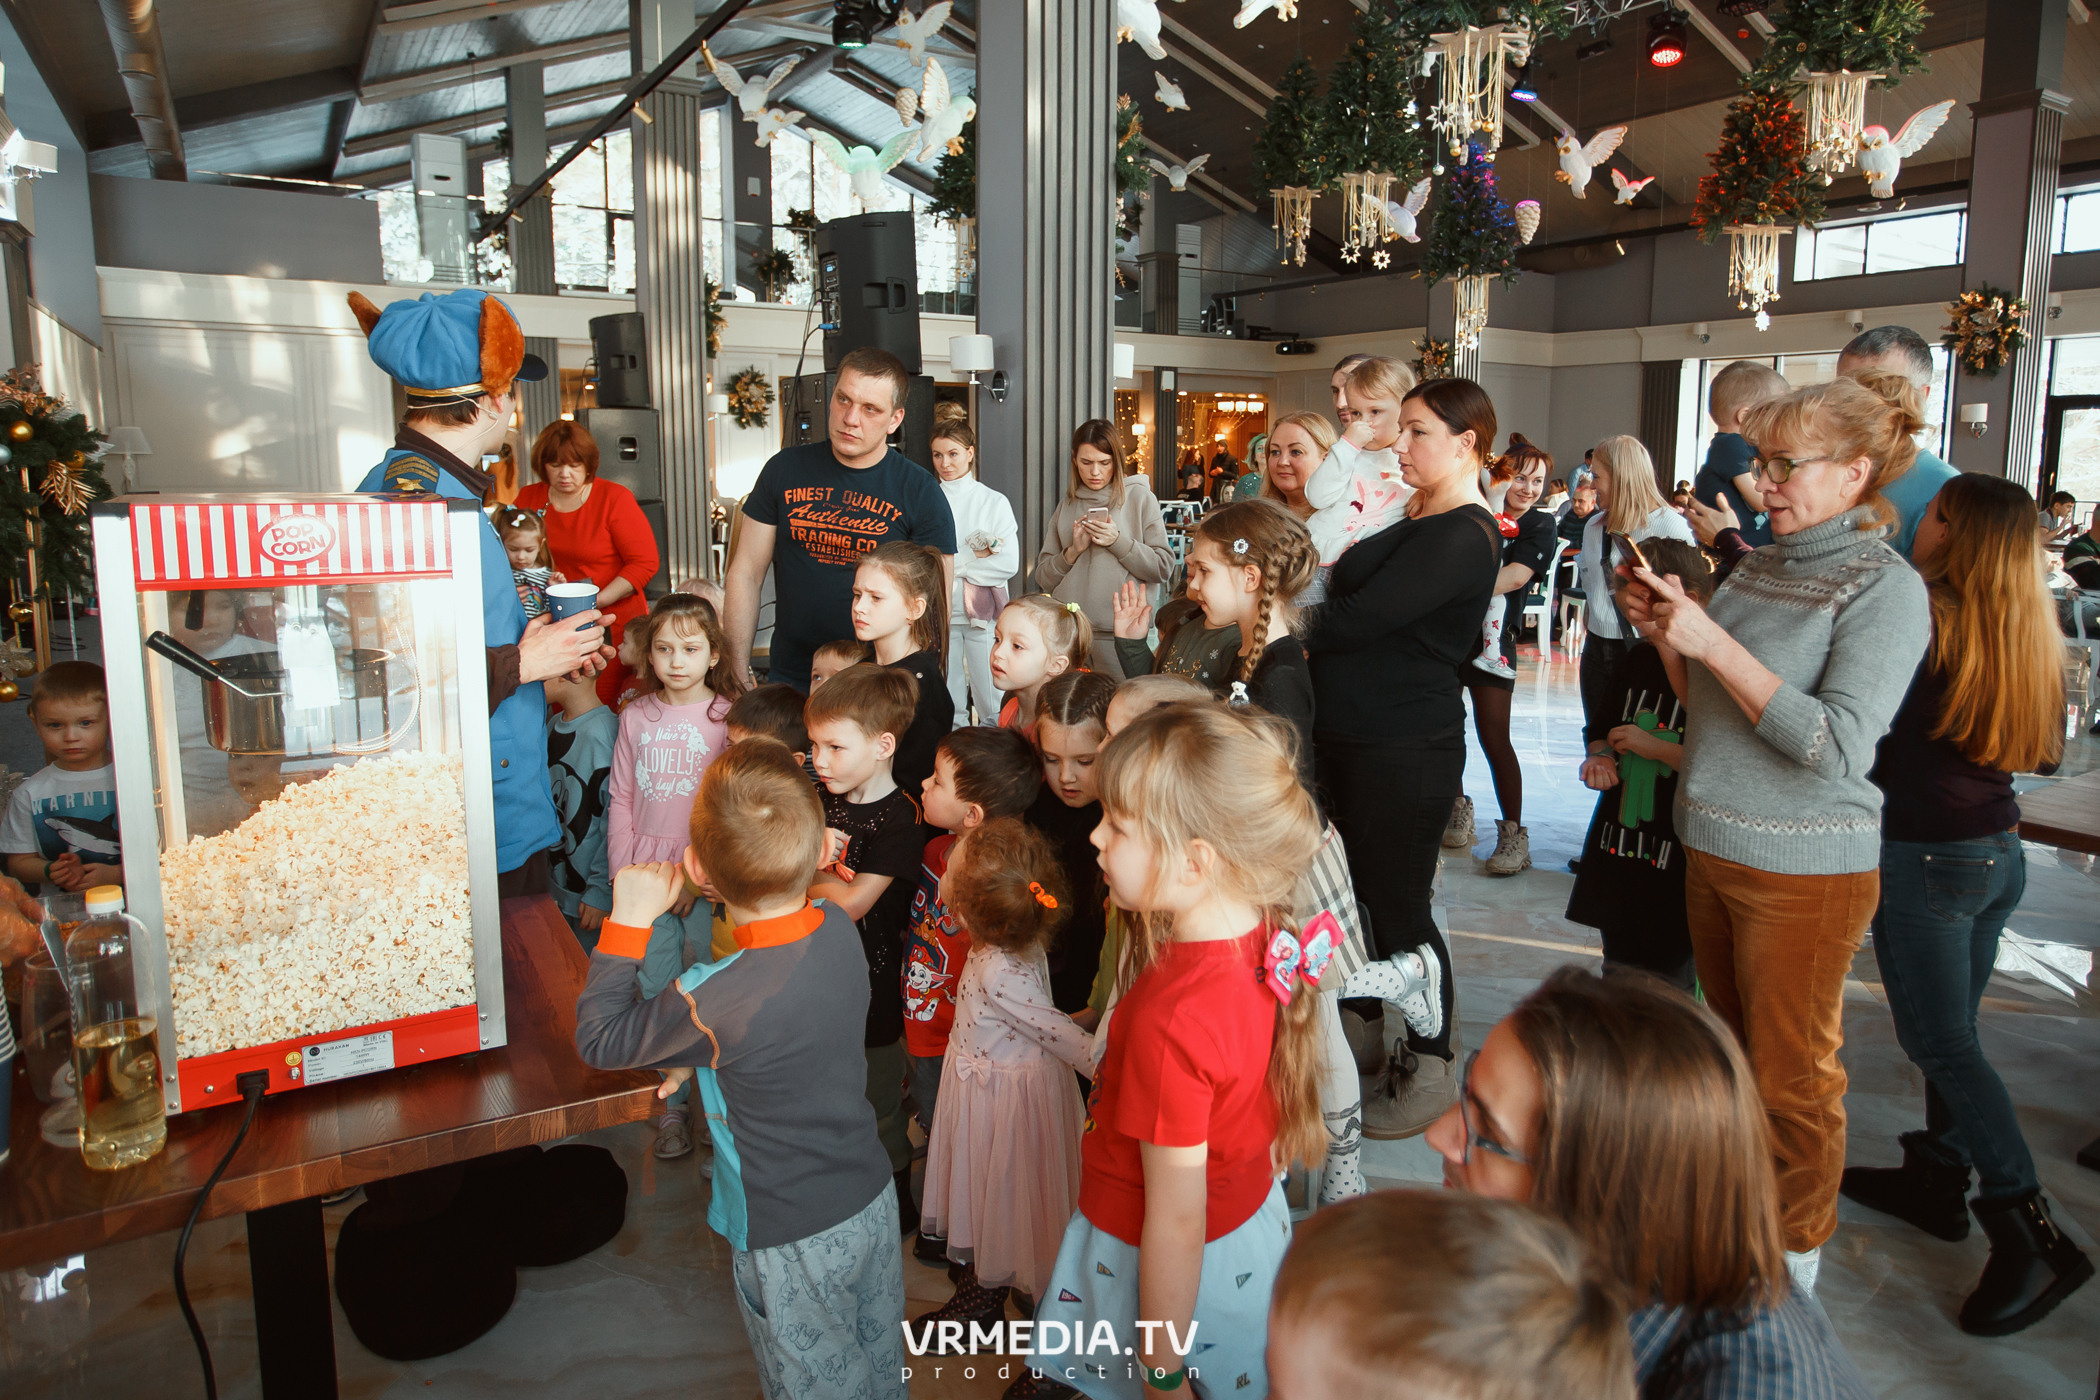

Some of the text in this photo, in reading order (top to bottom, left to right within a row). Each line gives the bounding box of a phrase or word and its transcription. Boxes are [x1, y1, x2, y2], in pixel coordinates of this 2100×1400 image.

[784, 487, 834, 505] FINEST
[842, 489, 903, 522] QUALITY
[787, 503, 889, 534] Authentic
[270, 523, 313, 542] POP
[789, 525, 852, 549] TRADING
[270, 534, 326, 557] CORN
[654, 726, 688, 742] Have a
[644, 746, 695, 776] LOVELY
[655, 777, 676, 797] day!
[1235, 1372, 1251, 1390] RL
